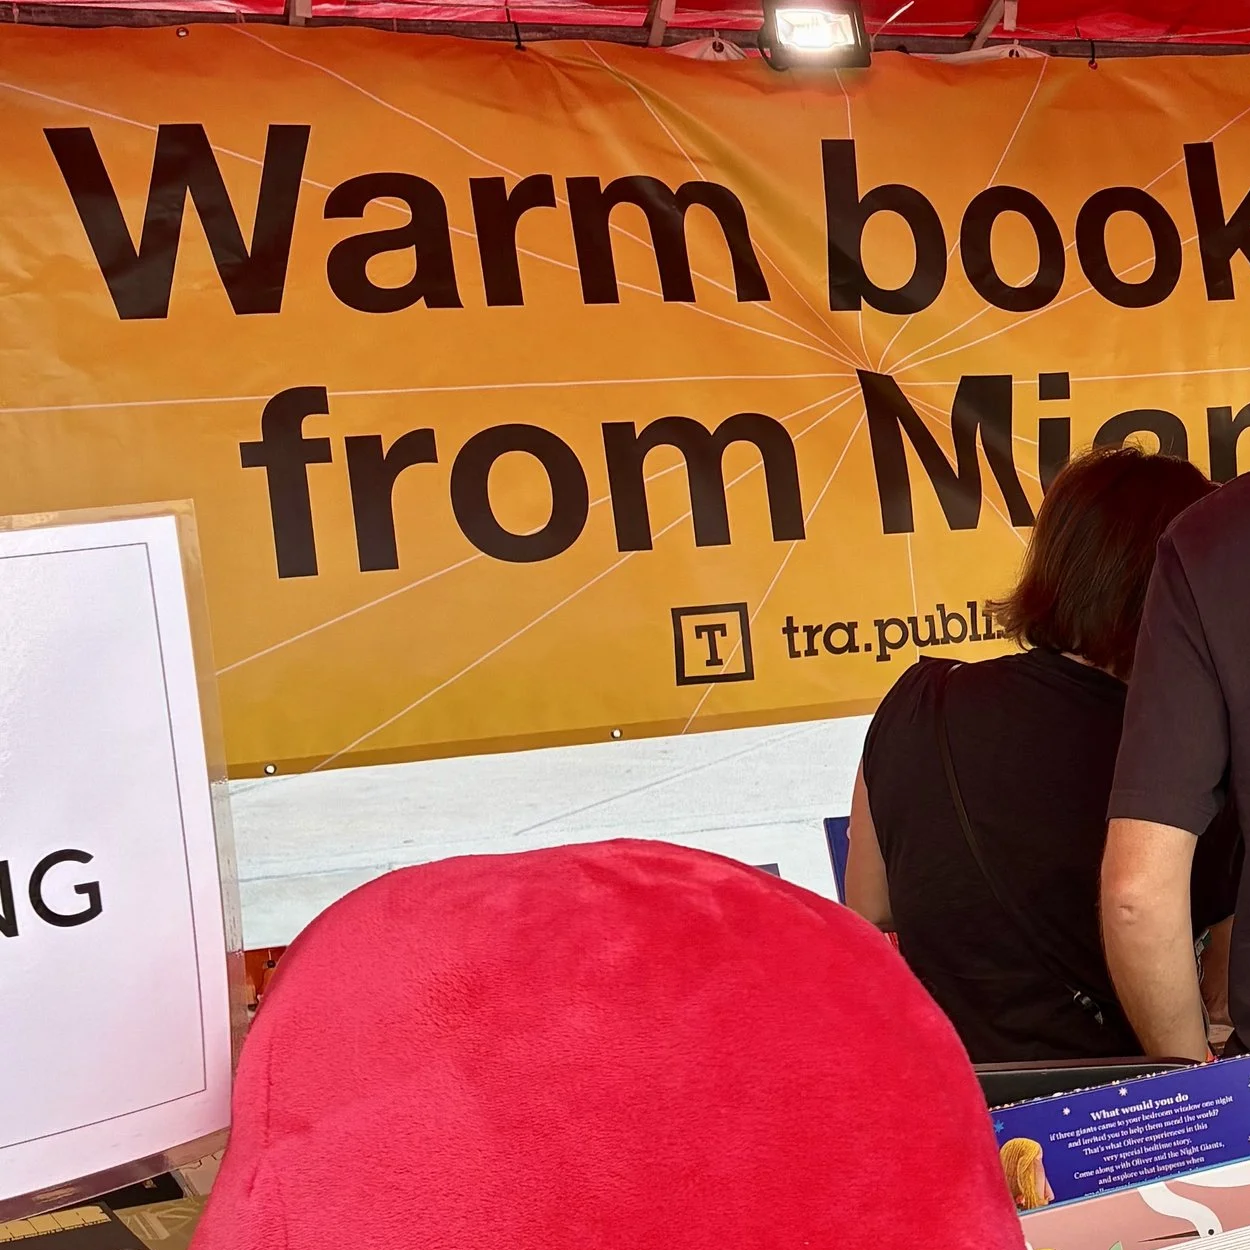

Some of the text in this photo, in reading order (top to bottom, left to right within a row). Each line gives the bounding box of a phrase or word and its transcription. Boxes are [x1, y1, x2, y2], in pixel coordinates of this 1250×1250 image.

[43, 124, 771, 320] Warm
[240, 387, 805, 578] from
[782, 599, 1006, 664] tra.publi
[1050, 1133, 1056, 1141] if
[1056, 1131, 1075, 1140] three
[1076, 1126, 1097, 1137] giants
[1098, 1122, 1116, 1131] came
[1125, 1116, 1141, 1126] your
[1142, 1110, 1173, 1121] bedroom
[1215, 1096, 1233, 1105] night
[1090, 1093, 1189, 1121] What would you do
[1068, 1138, 1082, 1148] and
[1082, 1133, 1107, 1145] invited
[1107, 1132, 1120, 1141] you
[1129, 1126, 1144, 1135] help
[1142, 1123, 1163, 1132] them
[1164, 1116, 1184, 1127] mend
[1184, 1115, 1196, 1123] the
[1196, 1109, 1219, 1120] world?
[1083, 1145, 1105, 1156] That's
[1105, 1142, 1122, 1150] what
[1123, 1137, 1144, 1147] Oliver
[1194, 1122, 1208, 1131] this
[1074, 1142, 1225, 1179] Come along with Oliver and the Night Giants,
[1103, 1138, 1192, 1162] very special bedtime story.
[1099, 1157, 1205, 1185] and explore what happens when
